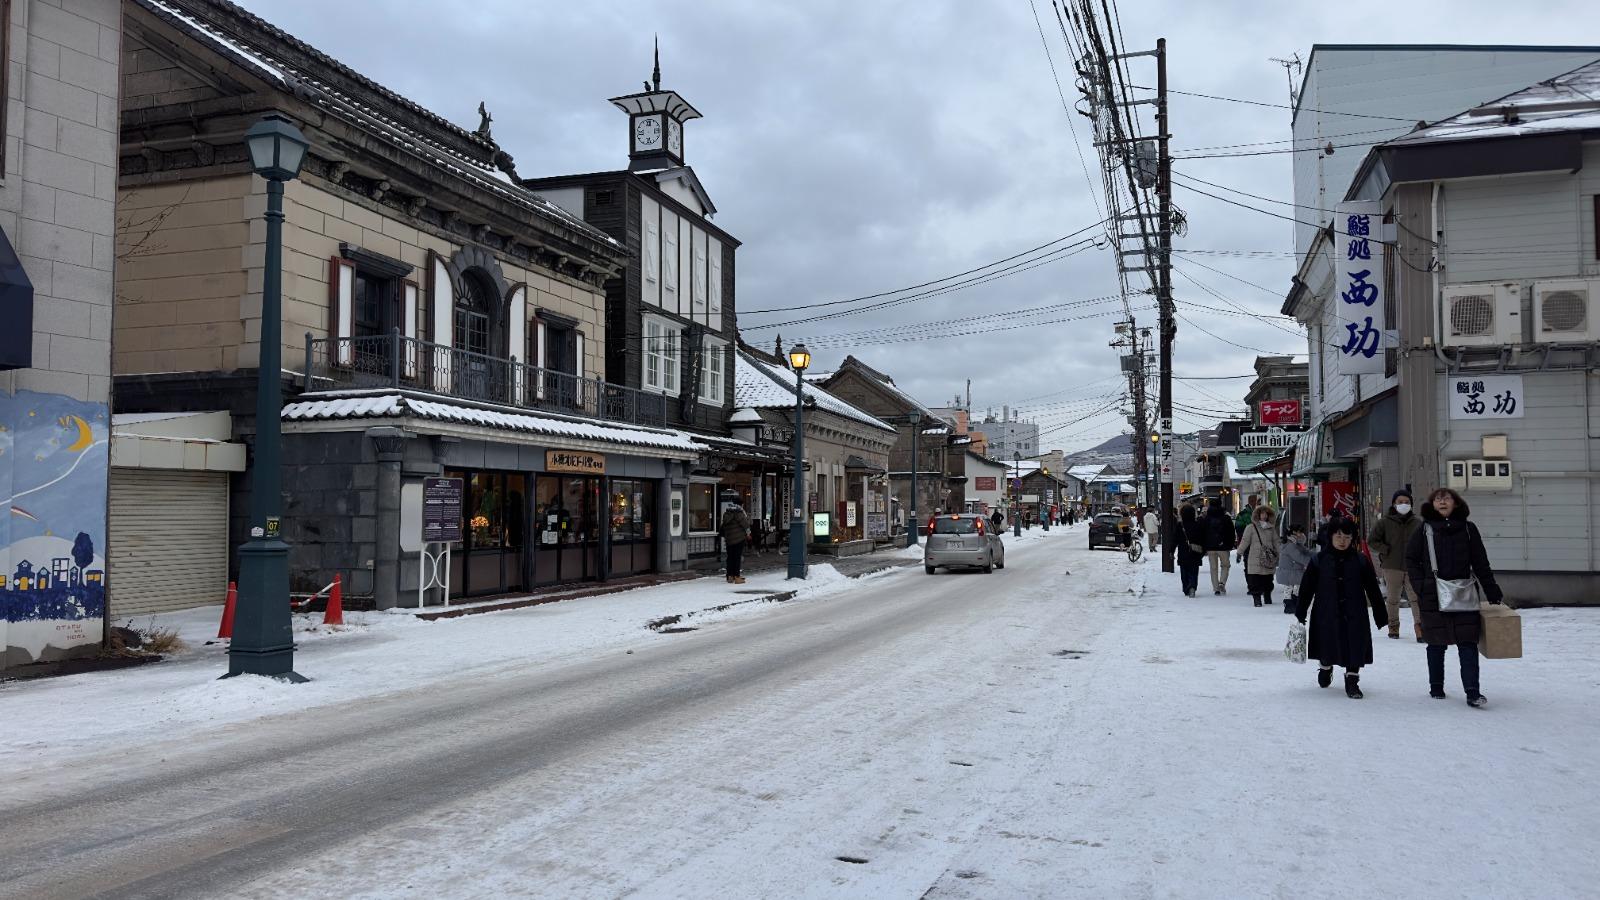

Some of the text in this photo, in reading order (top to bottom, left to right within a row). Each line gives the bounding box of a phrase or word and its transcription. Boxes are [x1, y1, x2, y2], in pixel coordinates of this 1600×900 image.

[1456, 381, 1485, 394] 鮨処
[1263, 404, 1296, 415] ラーメン
[1161, 419, 1172, 461] 北一硝子
[1243, 434, 1307, 447] 出世前広
[1325, 436, 1333, 459] くすり
[268, 521, 278, 531] 07
